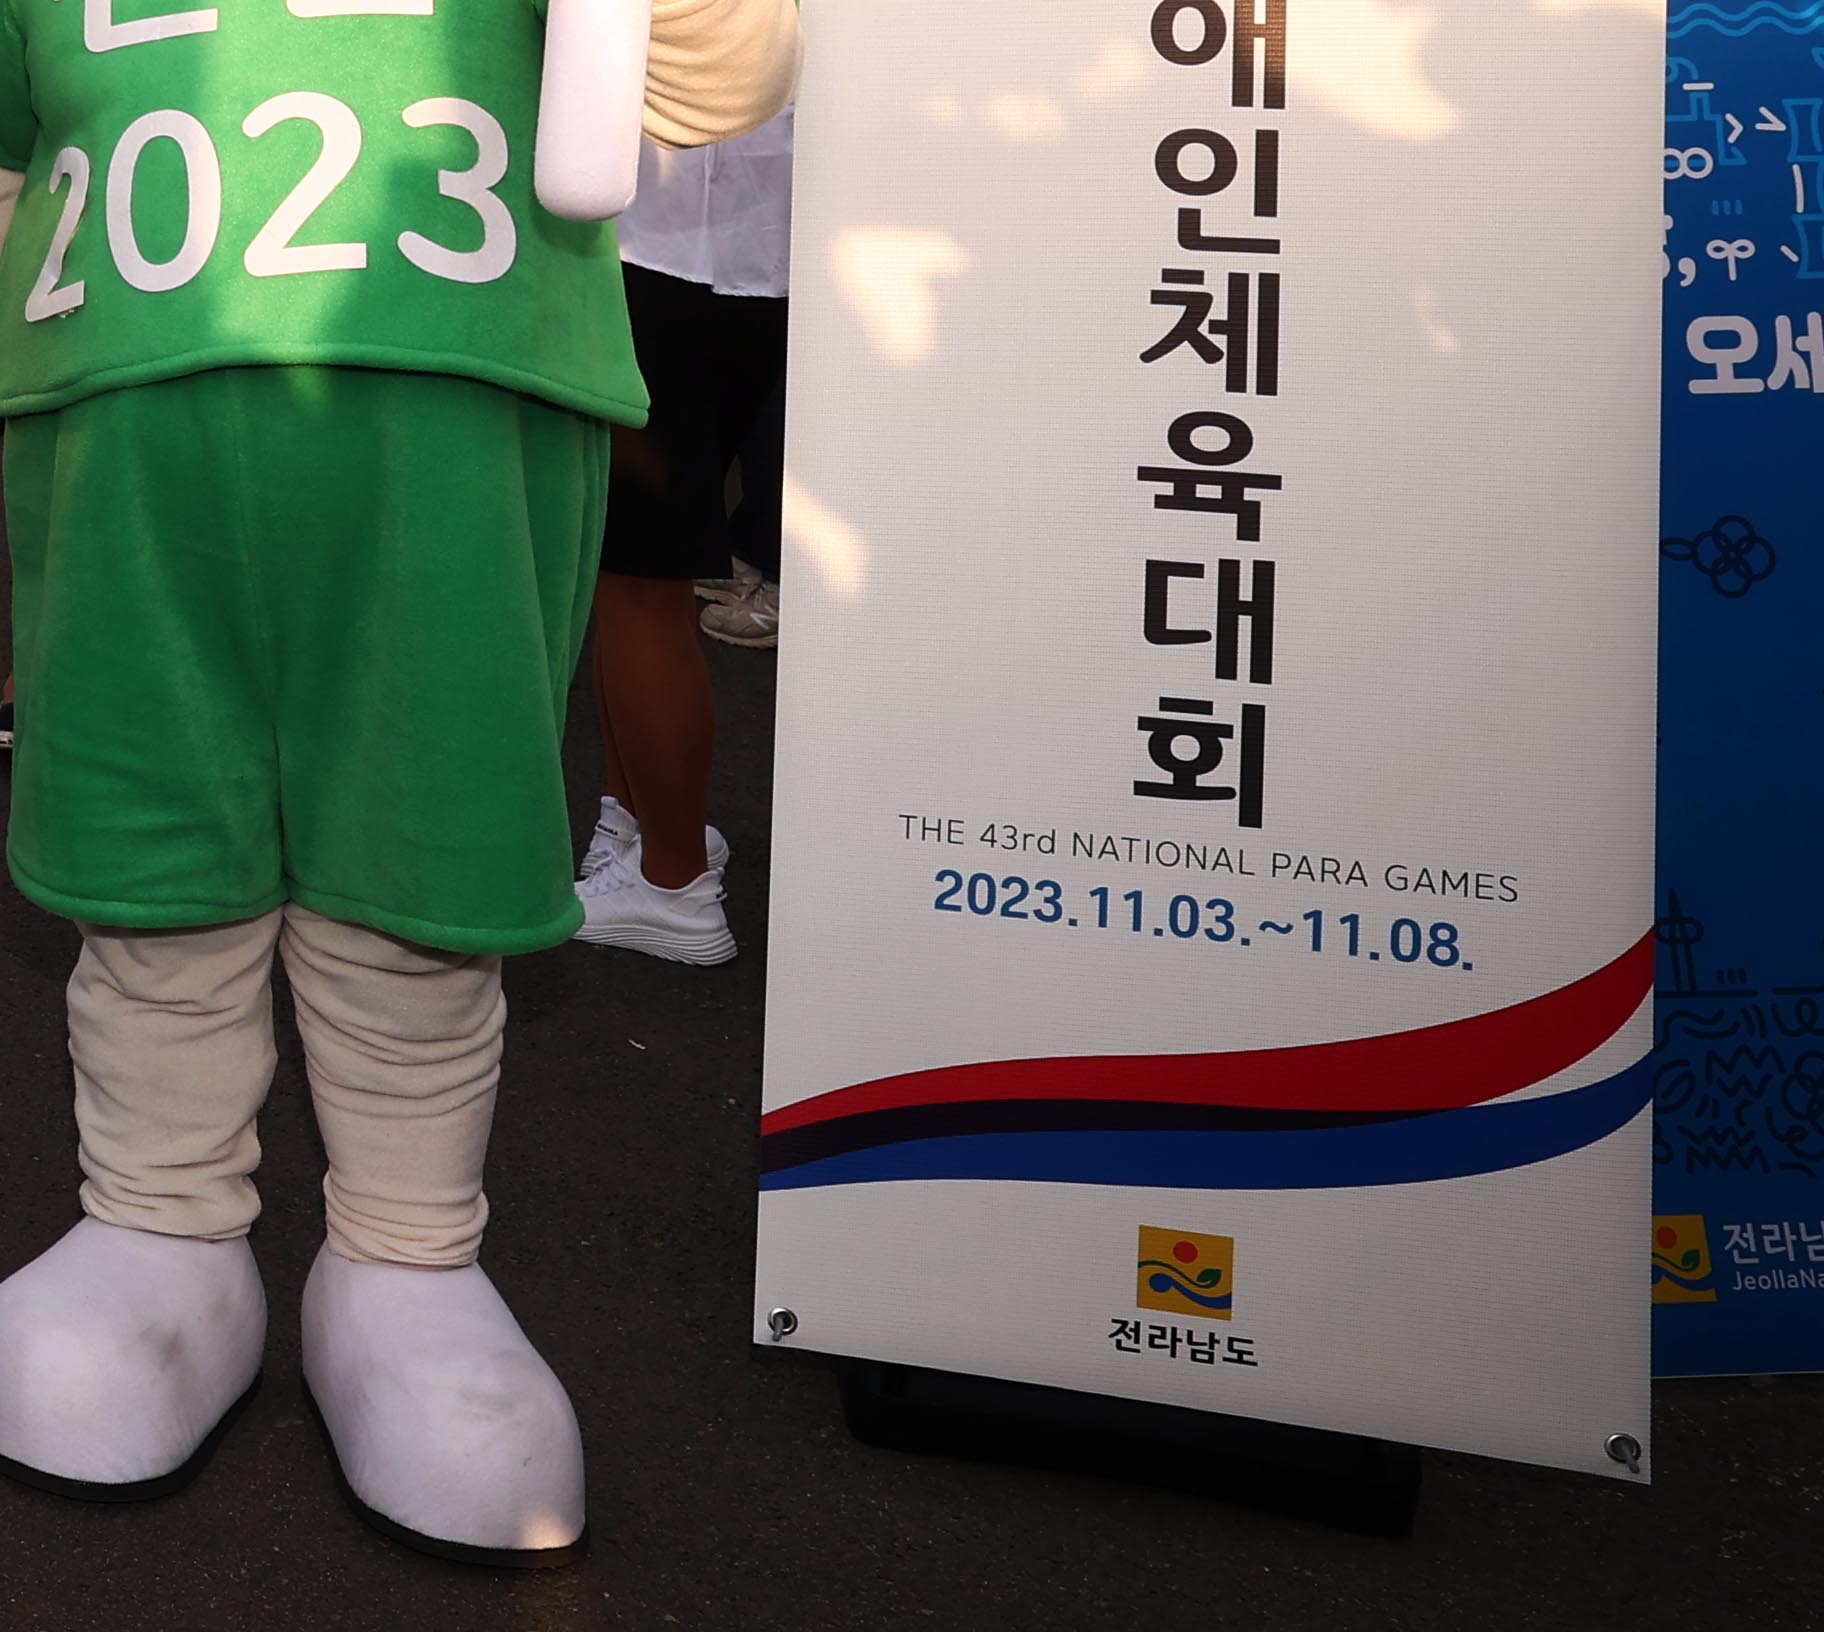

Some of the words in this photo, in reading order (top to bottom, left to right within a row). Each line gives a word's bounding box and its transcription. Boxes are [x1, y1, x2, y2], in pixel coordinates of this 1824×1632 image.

[25, 91, 517, 324] 2023
[899, 813, 965, 846] THE
[979, 821, 1057, 856] 43rd
[1072, 831, 1256, 877] NATIONAL
[1270, 852, 1369, 889] PARA
[1384, 862, 1521, 904] GAMES
[934, 868, 1474, 972] 2023.11.03.~11.08.
[1108, 1318, 1258, 1368] 전라남도
